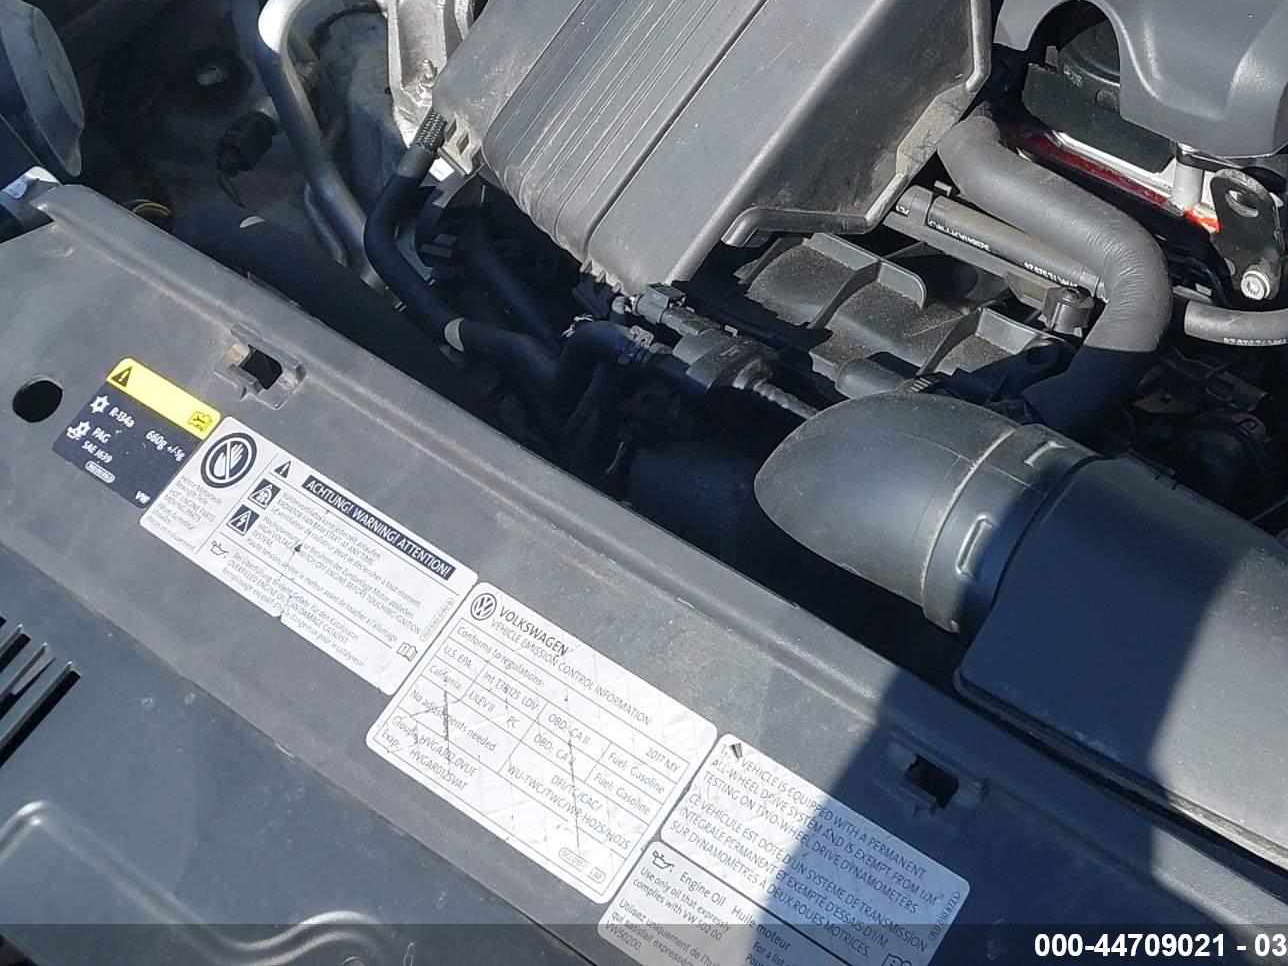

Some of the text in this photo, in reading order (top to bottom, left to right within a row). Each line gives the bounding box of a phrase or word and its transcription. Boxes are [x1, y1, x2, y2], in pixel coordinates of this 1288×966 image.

[80, 439, 113, 464] SAE J639
[90, 426, 111, 443] PAG
[107, 405, 137, 428] R-134a
[146, 430, 167, 451] 660g
[135, 490, 150, 505] VW
[305, 477, 452, 577] ACHTUNG! WARNING! ATTENTION!
[497, 605, 570, 657] VOLKSWAGEN
[455, 625, 494, 654] Conforms
[644, 746, 666, 765] 2017
[663, 759, 681, 775] MY
[489, 618, 522, 644] VEHICLE
[519, 637, 559, 667] EMISSION
[556, 660, 596, 691] CONTROL
[593, 684, 652, 726] INFORMATION
[408, 688, 425, 703] No
[465, 727, 500, 754] needed.
[481, 670, 497, 684] Int
[519, 695, 539, 712] LDV
[546, 713, 570, 732] OBD:
[568, 727, 584, 741] CA
[606, 752, 630, 771] Fuel:
[628, 766, 666, 795] Gasoline
[504, 714, 520, 729] PC
[532, 733, 556, 753] OBD:
[553, 747, 570, 762] CA
[592, 772, 615, 792] Fuel:
[613, 786, 652, 815] Gasoline
[700, 770, 741, 801] TESTING
[737, 793, 757, 811] ON
[754, 804, 815, 847] TWO-WHEEL
[810, 839, 843, 865] DRIVE
[710, 757, 762, 795] ALL-WHEEL
[758, 787, 789, 812] DRIVE
[786, 805, 823, 834] SYSTEM
[821, 827, 846, 848] AND
[843, 841, 856, 854] IS
[853, 847, 892, 877] EXEMPT
[890, 871, 922, 896] FROM
[738, 756, 927, 880] VEHICLE IS EQUIPPED WITH A PERMANENT
[668, 819, 691, 839] SUR
[765, 882, 796, 907] DEUX
[791, 899, 826, 926] ROUES
[687, 793, 702, 808] CE
[740, 827, 759, 843] EST
[756, 835, 786, 860] DOTÉ
[844, 893, 860, 909] DE
[857, 901, 929, 953] TRANSMISSION
[722, 835, 778, 875] PERMANENT
[773, 868, 788, 882] ET
[607, 910, 653, 944] qui satisfait
[616, 898, 703, 960] Utilisez uniquement de
[629, 877, 667, 906] complies
[662, 898, 685, 916] with
[681, 910, 698, 925] VW
[638, 866, 733, 934] Use only oil that expressly
[676, 871, 794, 952] Engine Oil Huile moteur
[750, 940, 767, 956] For
[769, 953, 786, 966] list
